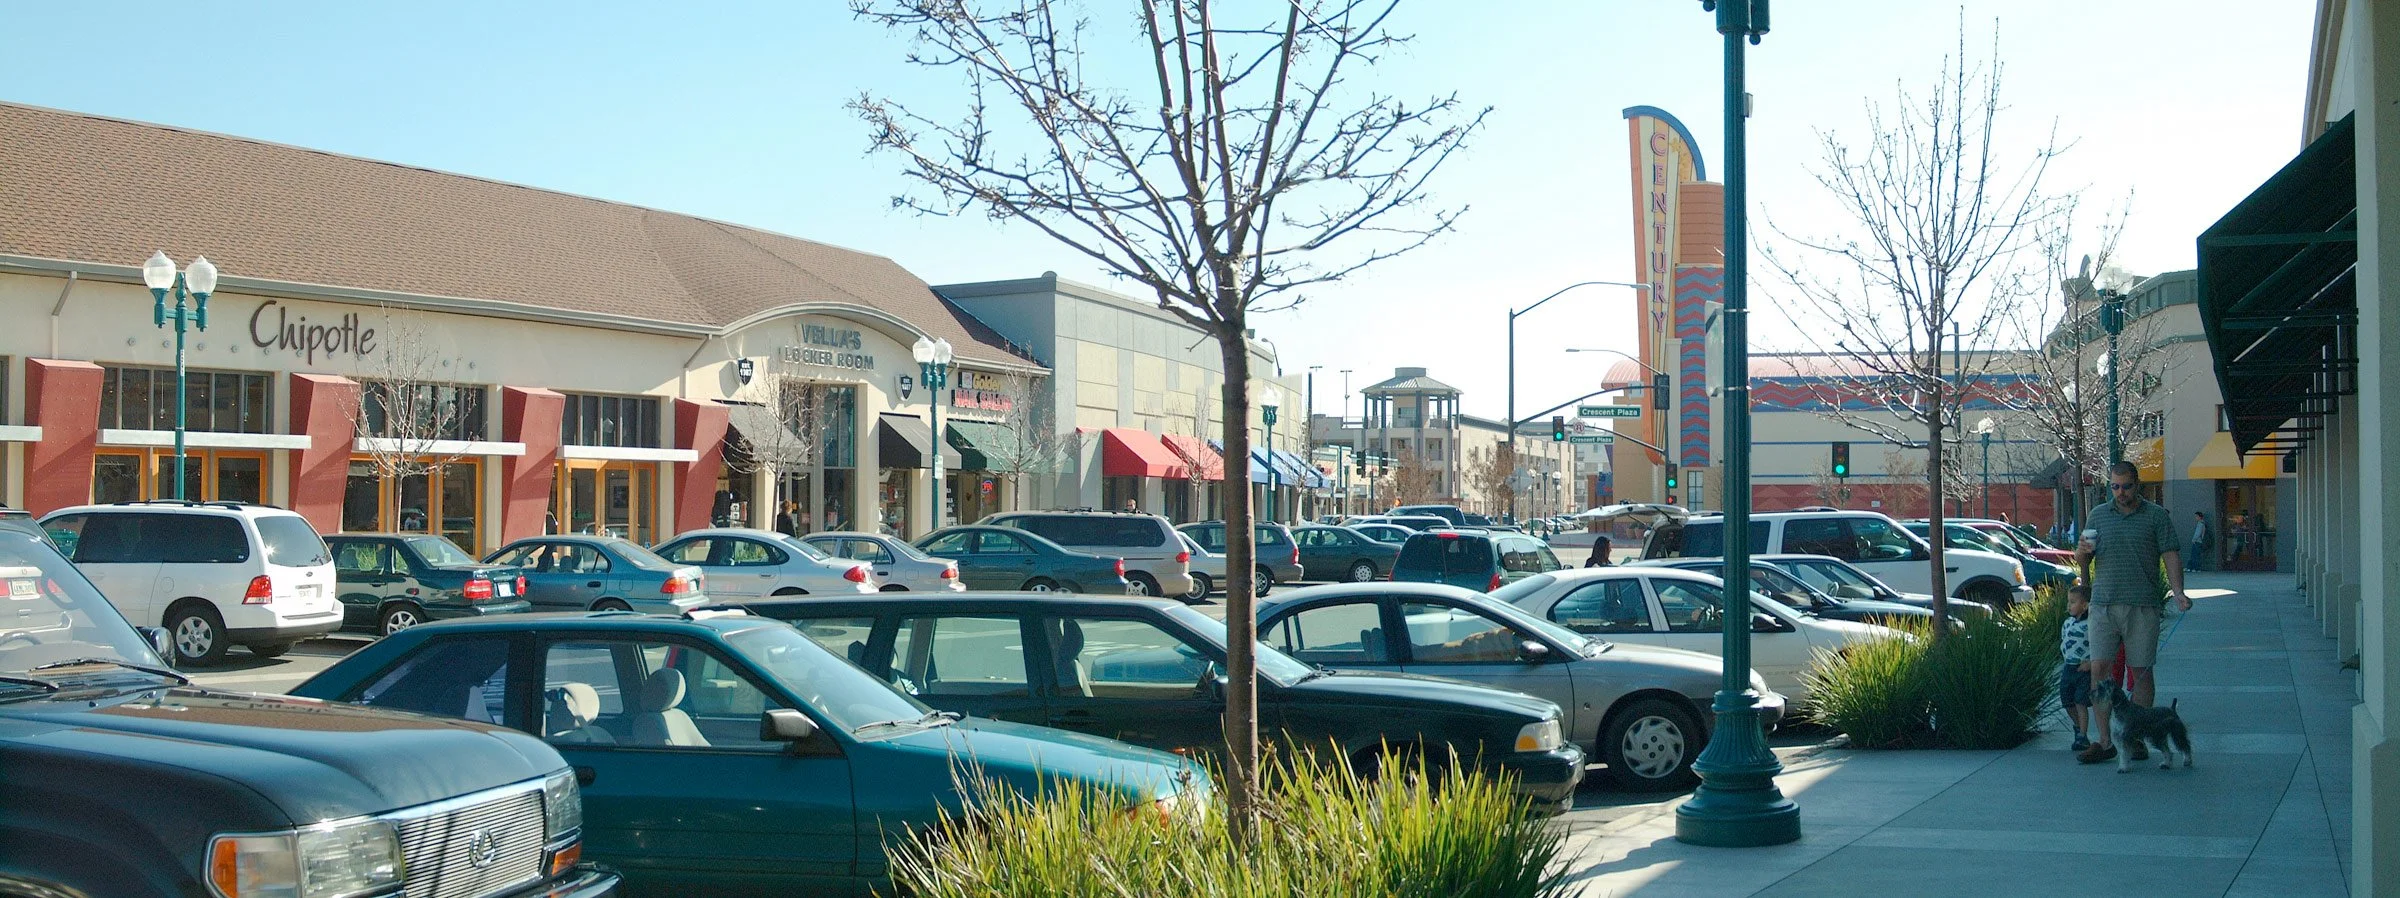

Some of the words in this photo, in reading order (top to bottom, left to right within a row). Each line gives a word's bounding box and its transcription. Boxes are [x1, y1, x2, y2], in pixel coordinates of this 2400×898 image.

[1650, 133, 1667, 334] CENTURY
[249, 300, 377, 366] Chipotle
[801, 323, 861, 349] VELLA'S
[784, 345, 833, 367] LOCKER
[837, 351, 875, 371] ROOM
[1582, 408, 1615, 416] Crescent
